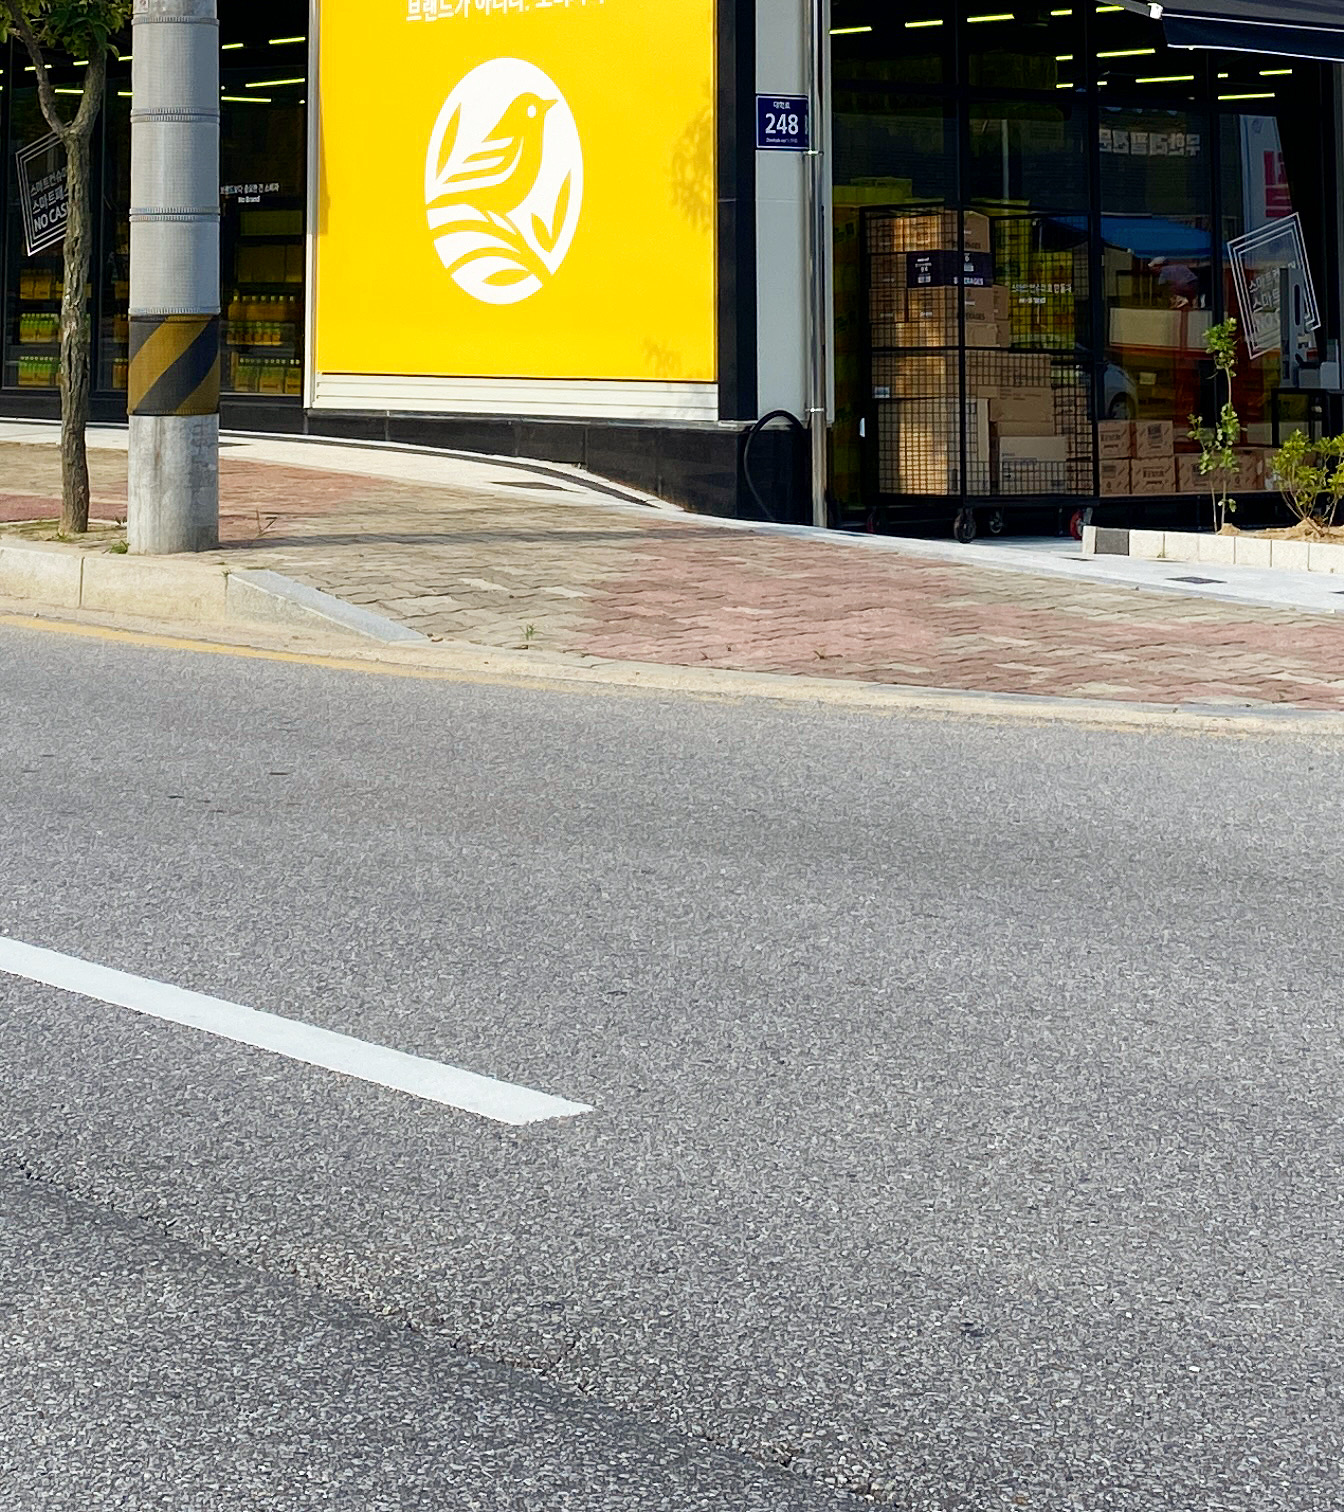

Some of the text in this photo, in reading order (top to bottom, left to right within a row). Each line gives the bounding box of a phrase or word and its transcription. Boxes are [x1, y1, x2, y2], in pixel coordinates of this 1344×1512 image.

[765, 113, 798, 135] 248
[34, 201, 68, 233] NO CAS
